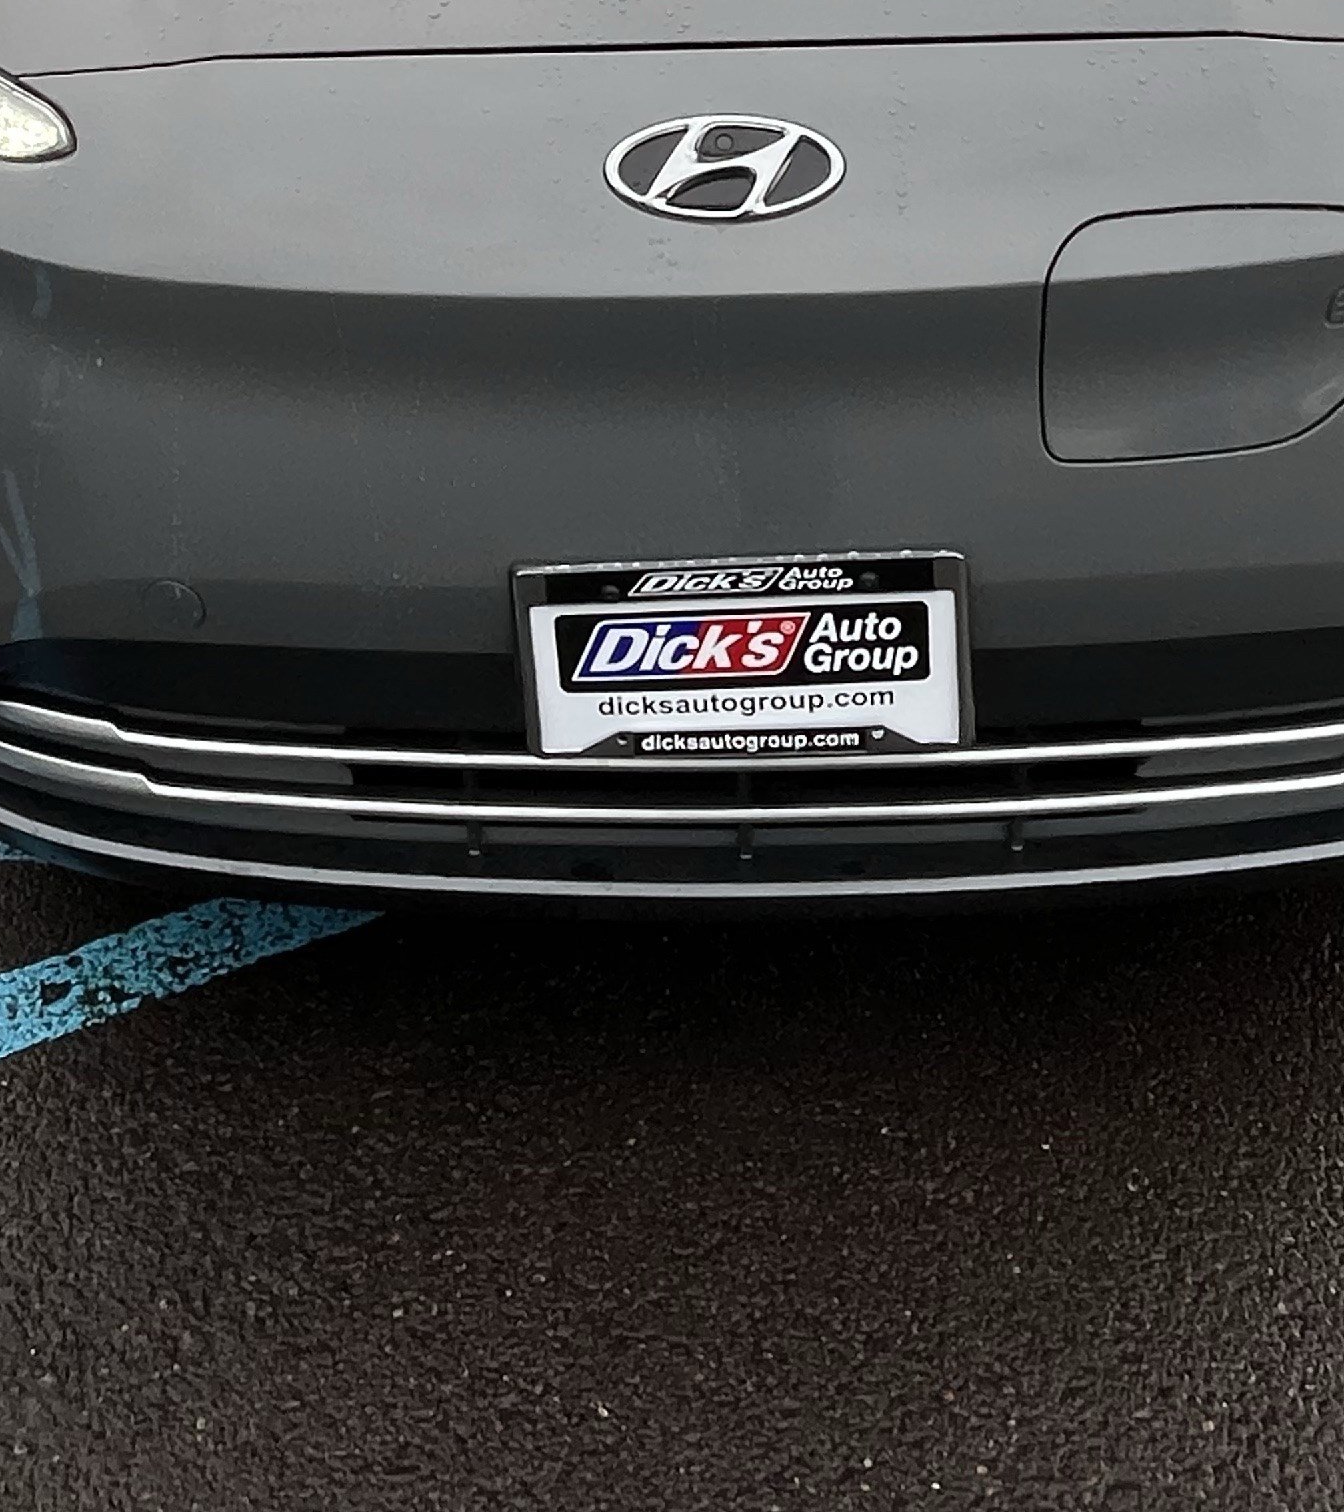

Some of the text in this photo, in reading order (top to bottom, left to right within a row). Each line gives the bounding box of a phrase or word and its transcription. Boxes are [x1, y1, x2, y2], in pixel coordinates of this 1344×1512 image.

[638, 566, 844, 594] Dick's Auto
[778, 576, 854, 592] Group
[590, 613, 902, 673] Dick's Auto
[804, 643, 919, 675] Group
[598, 689, 895, 717] dicksautogroup.com
[640, 729, 860, 753] dicksautogroup.com
